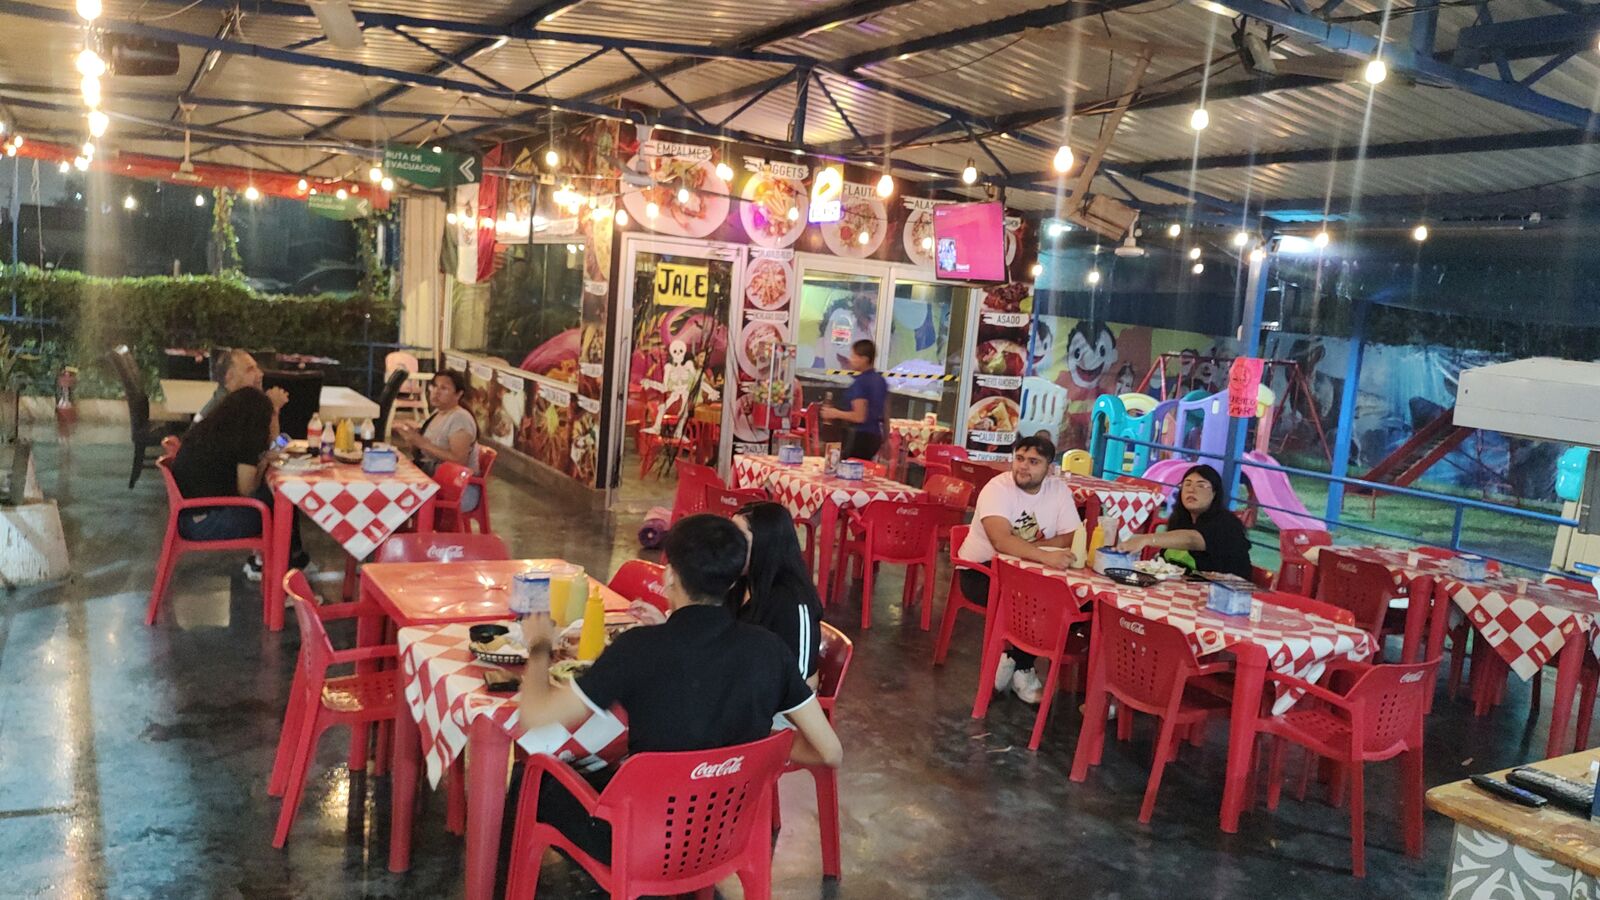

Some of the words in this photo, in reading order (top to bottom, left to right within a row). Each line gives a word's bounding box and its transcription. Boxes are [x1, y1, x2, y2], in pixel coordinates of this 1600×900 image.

[385, 152, 408, 161] RUTA
[410, 154, 422, 162] DE
[656, 143, 709, 160] EMPALMES
[759, 162, 804, 179] NGGETS
[658, 268, 706, 298] JALE
[996, 315, 1021, 325] ASADO
